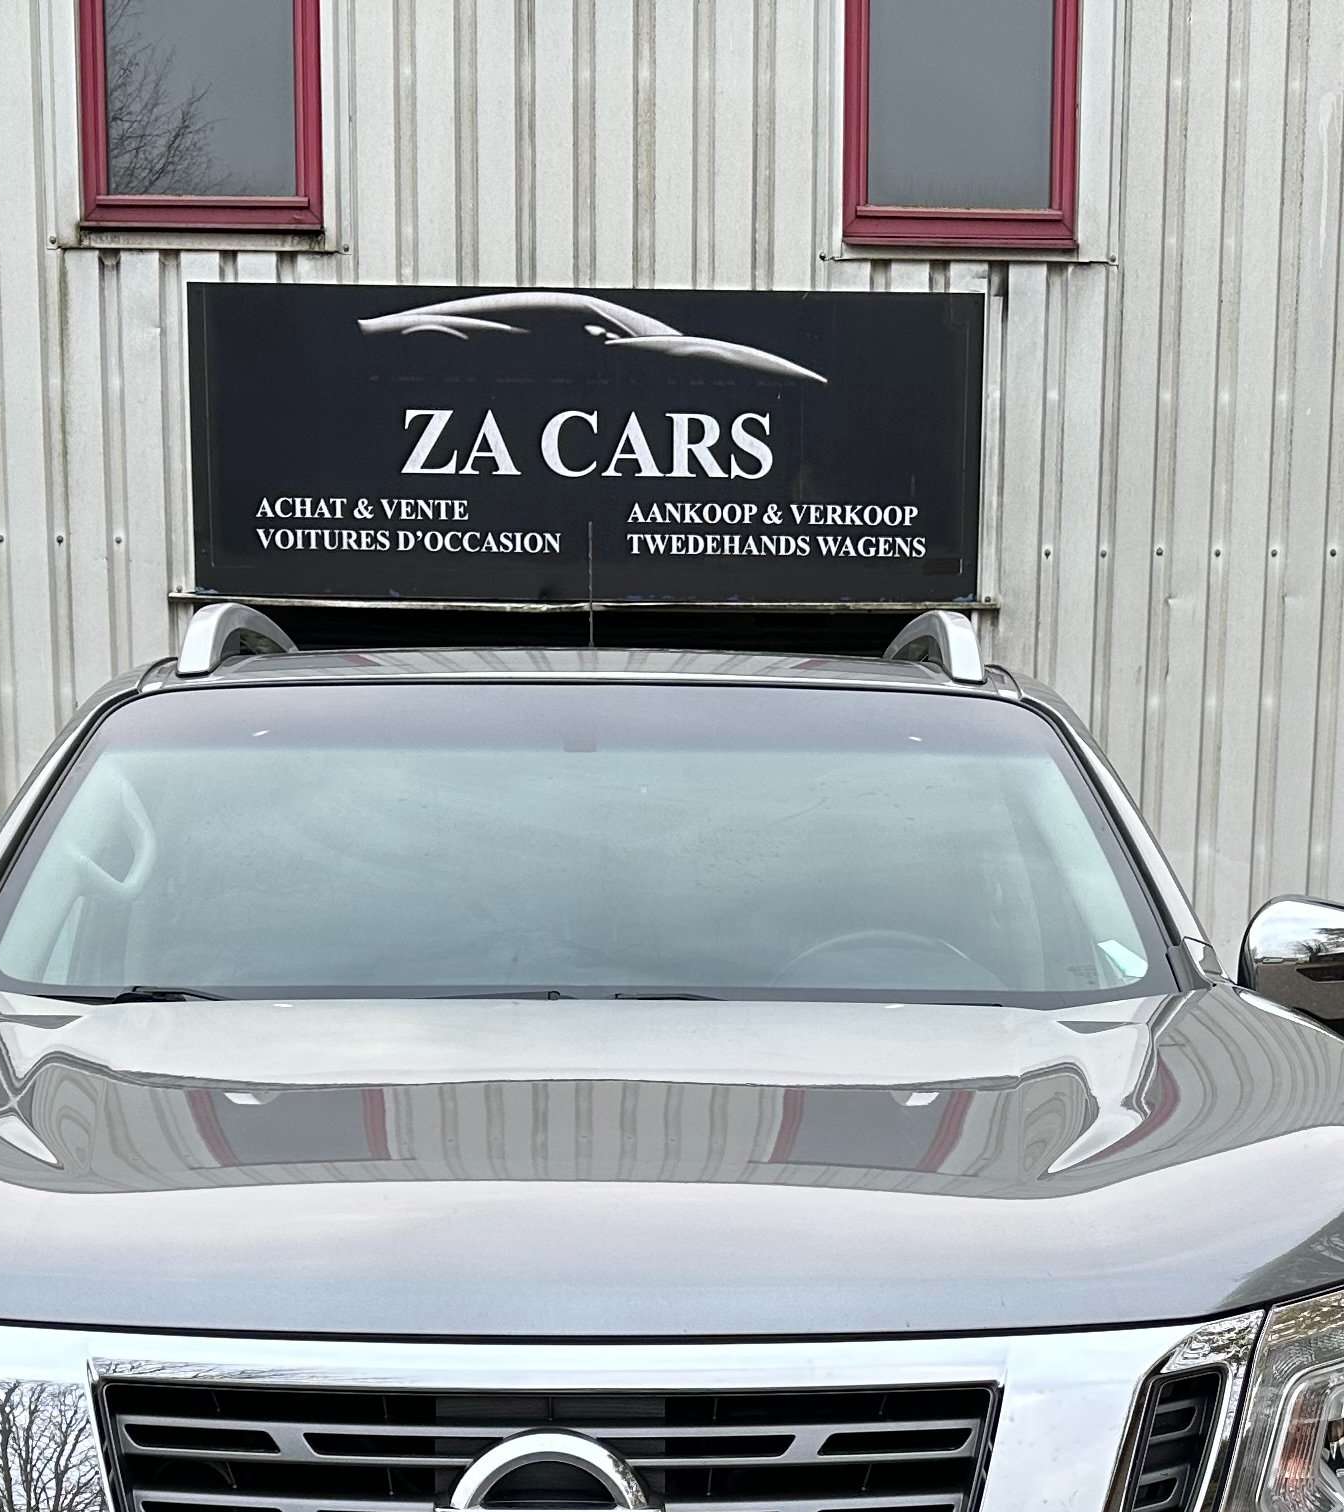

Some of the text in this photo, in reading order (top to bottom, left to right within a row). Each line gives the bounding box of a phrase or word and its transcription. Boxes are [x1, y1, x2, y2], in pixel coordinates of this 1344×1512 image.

[400, 409, 773, 480] ZA CARS
[255, 497, 469, 521] ACHAT & VENTE
[627, 502, 919, 527] AANKOOP & VERKOOP
[256, 528, 561, 554] VOITURES D'OCCASION
[626, 533, 926, 558] TWEDEHANDS WAGENS
